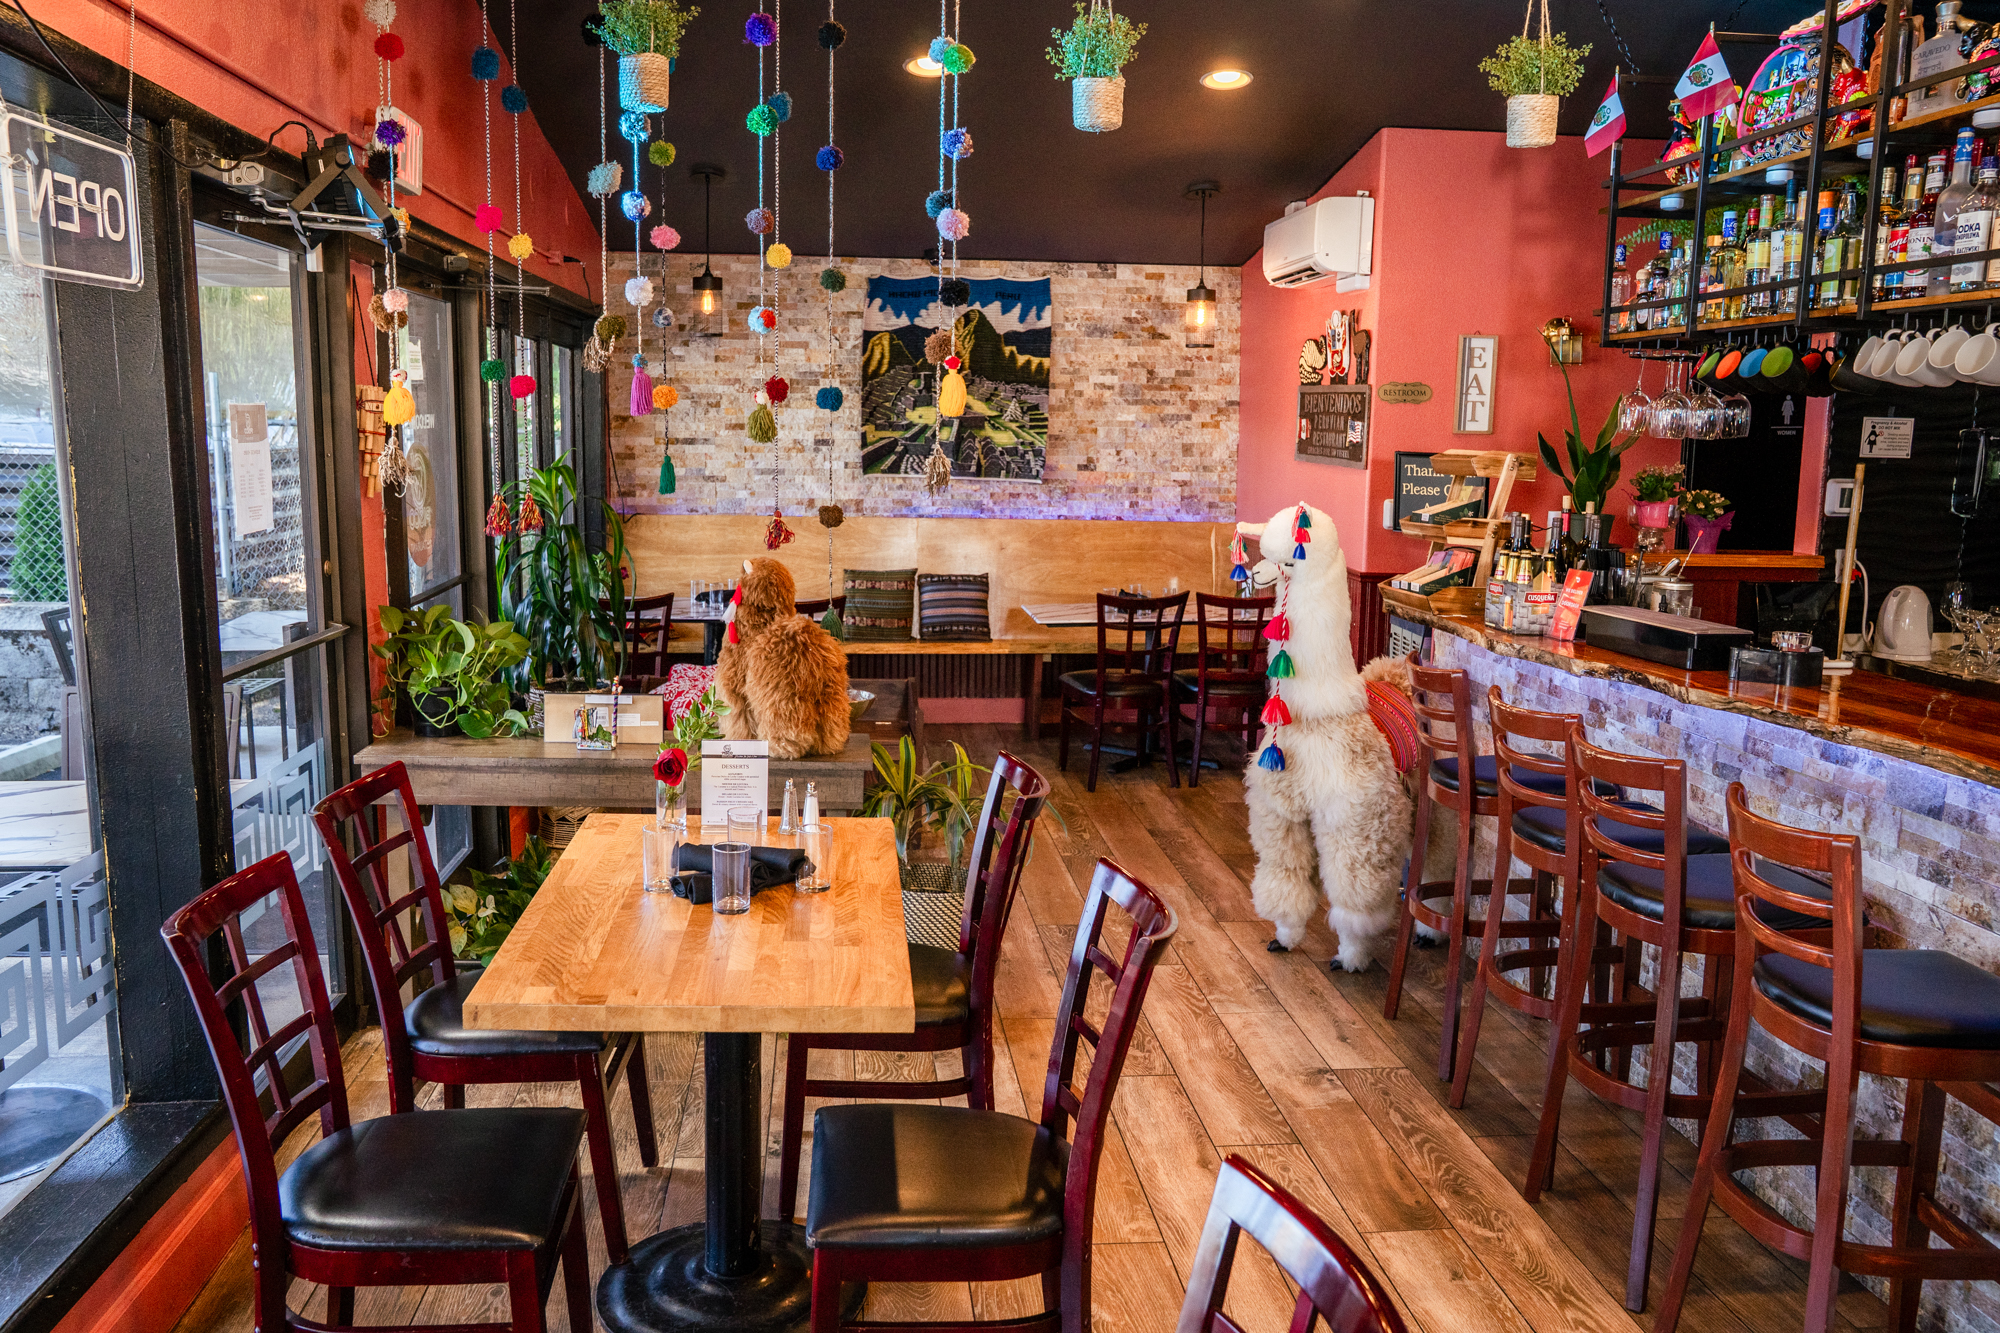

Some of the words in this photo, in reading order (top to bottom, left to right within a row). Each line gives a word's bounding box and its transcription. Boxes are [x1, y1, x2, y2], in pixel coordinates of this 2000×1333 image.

[1912, 44, 1951, 60] CARAVEDO
[1957, 222, 1981, 233] ODKA
[1908, 236, 1933, 245] ONIN
[1463, 347, 1487, 423] EAT
[1383, 389, 1427, 397] RESTROOM
[1304, 393, 1362, 414] BIENVENIDOS
[1314, 414, 1345, 431] PERUVIAN
[1312, 431, 1347, 448] RESTAURANT
[1402, 483, 1440, 496] Please
[1527, 593, 1555, 603] CUSQUEÑA
